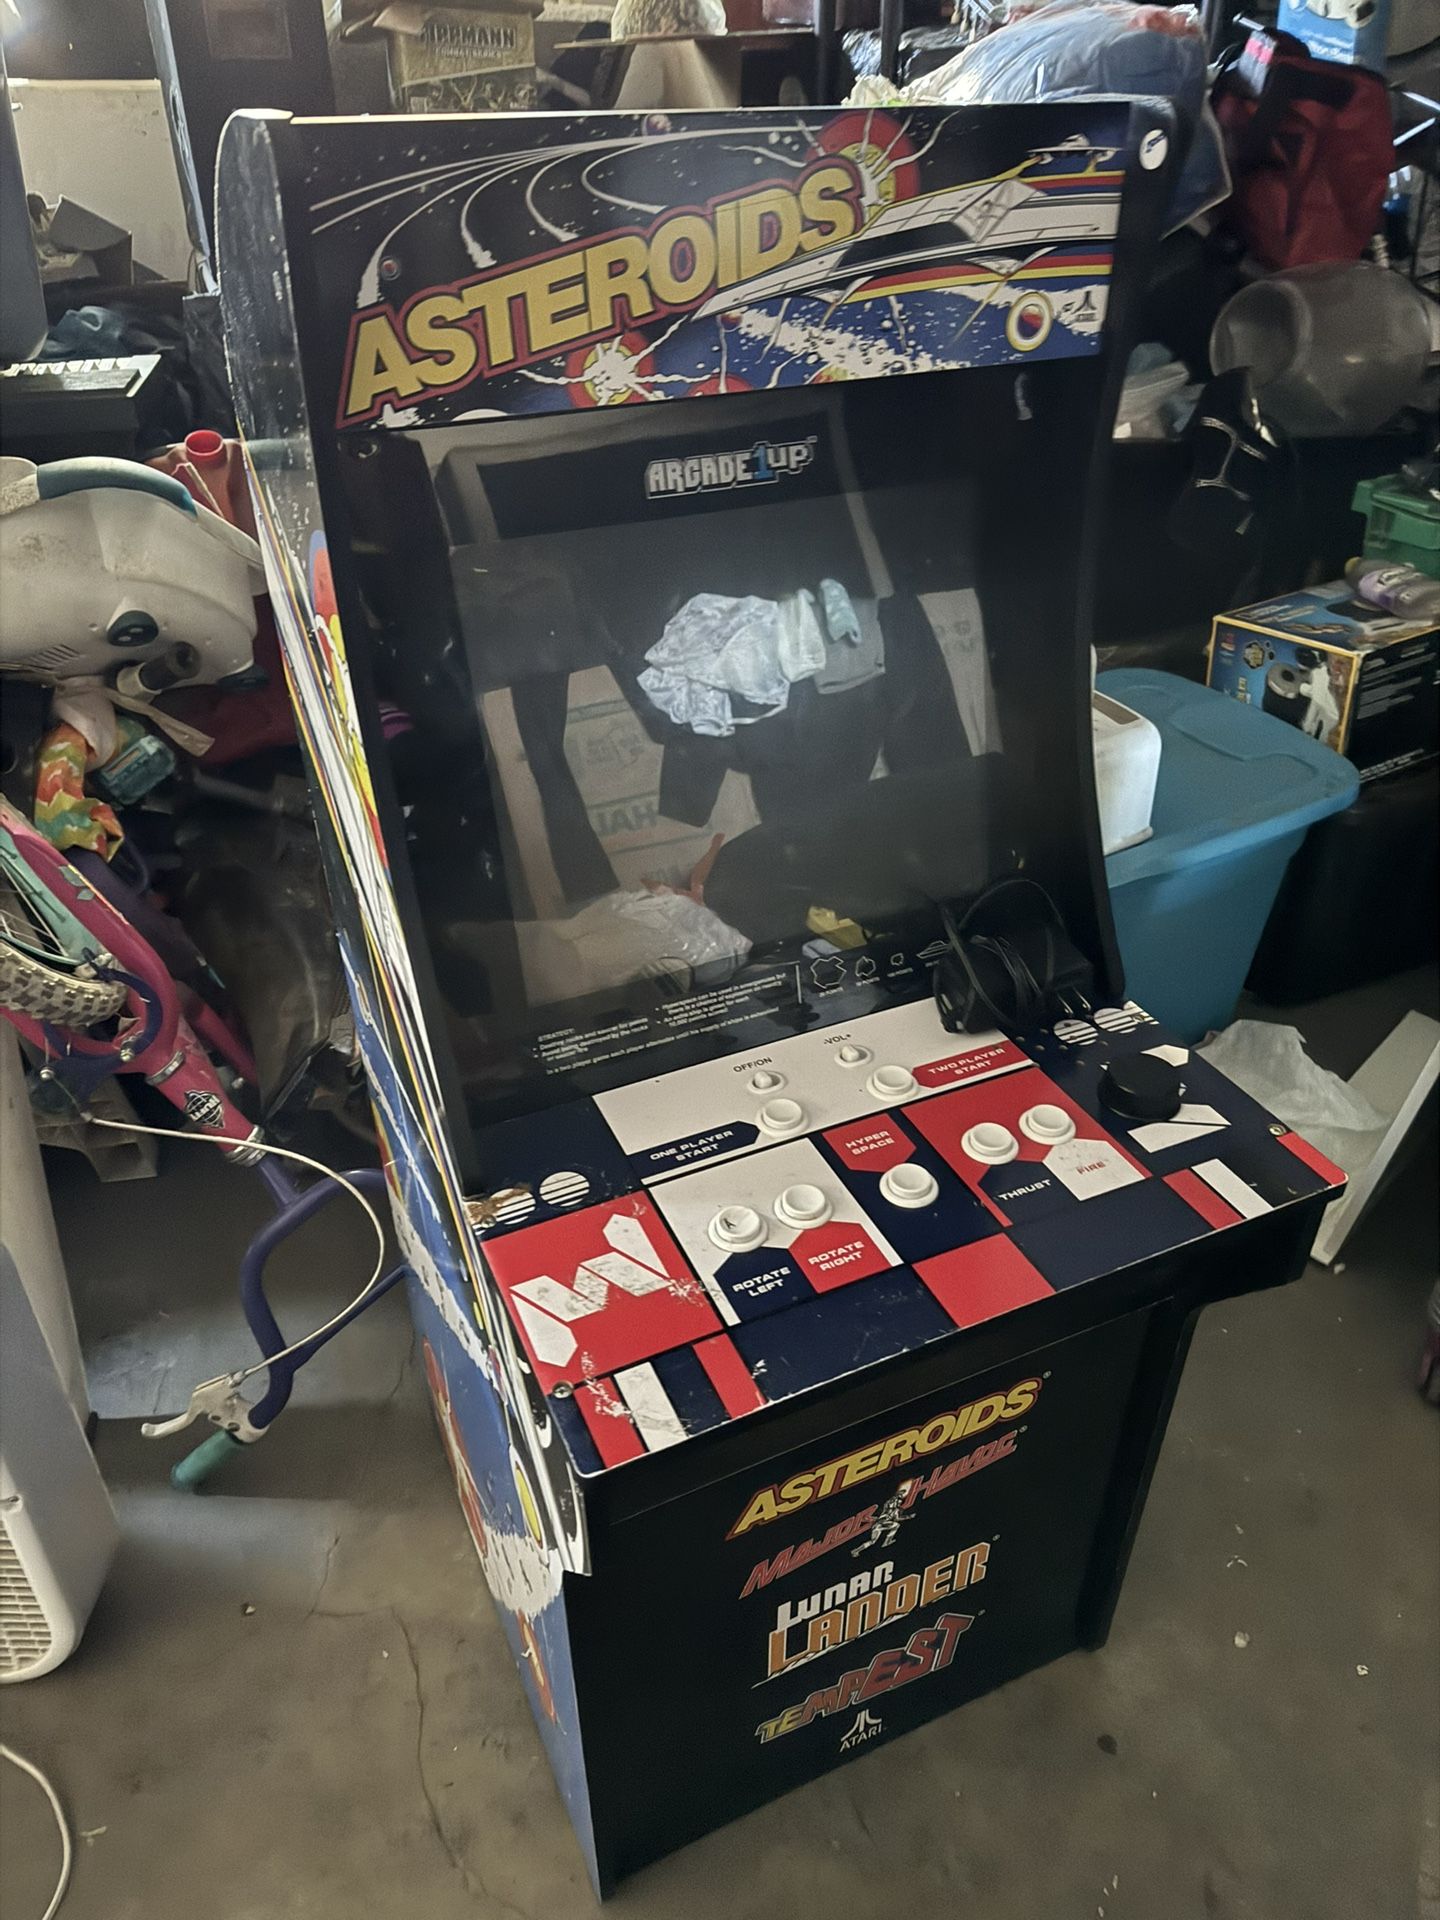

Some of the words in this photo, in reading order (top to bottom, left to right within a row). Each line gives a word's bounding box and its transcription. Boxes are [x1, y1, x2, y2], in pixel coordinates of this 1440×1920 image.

[341, 160, 860, 424] ASTEROIDS
[647, 444, 812, 494] ARCADE1UP
[733, 1056, 773, 1073] OFF/ON
[928, 1062, 956, 1075] TWO
[958, 1047, 1006, 1067] PLAYER
[953, 1060, 993, 1076] START
[649, 1147, 678, 1161] ONE
[680, 1130, 734, 1149] PLAYER
[675, 1143, 720, 1161] START
[845, 1130, 891, 1149] HYPER
[850, 1137, 896, 1156] SPACE
[1076, 1160, 1106, 1176] FIRE
[998, 1178, 1052, 1201] THRUST
[807, 1240, 865, 1265] ROTATE
[819, 1251, 863, 1272] RIGHT
[732, 1266, 792, 1293] ROTATE
[747, 1278, 785, 1297] LEFT
[726, 1377, 1042, 1541] ASTEROIDS
[777, 1560, 894, 1632] LUNAR
[767, 1542, 991, 1678] LANDER
[754, 1613, 976, 1744] TEMPEST
[839, 1721, 883, 1752] ATARI
